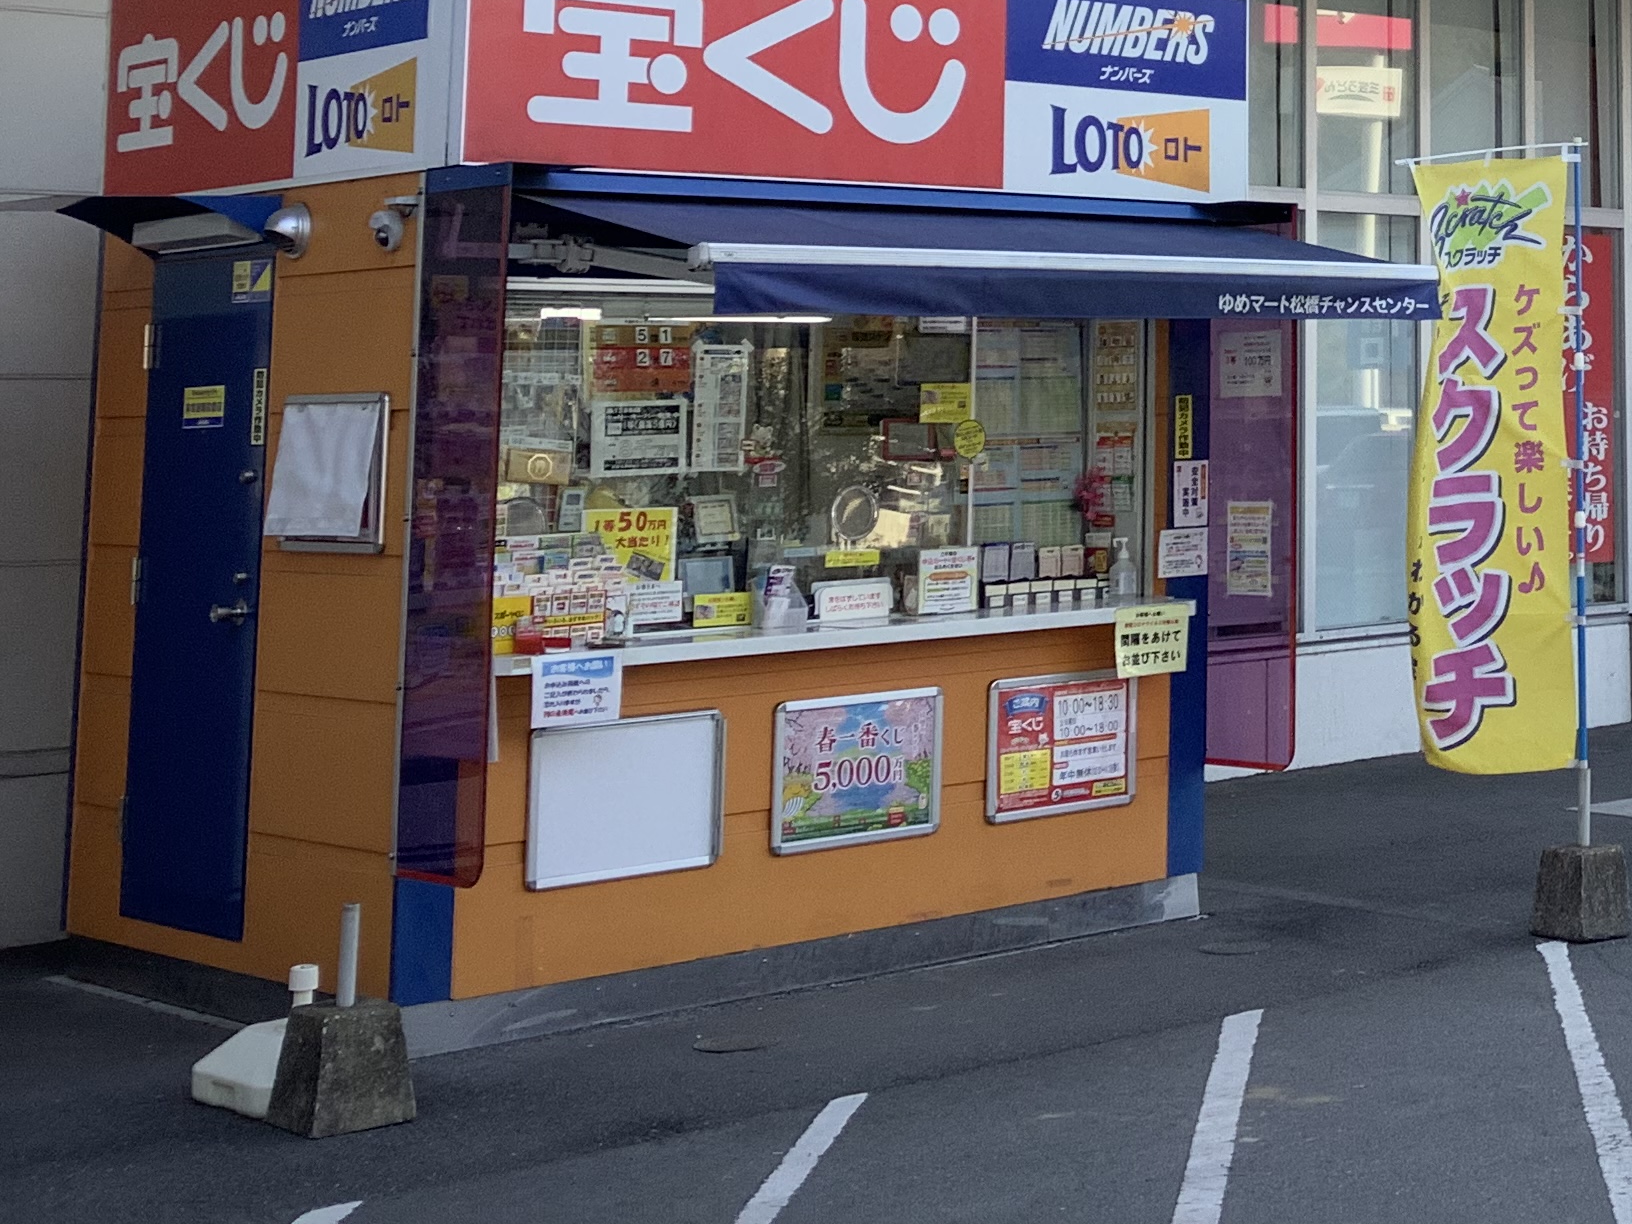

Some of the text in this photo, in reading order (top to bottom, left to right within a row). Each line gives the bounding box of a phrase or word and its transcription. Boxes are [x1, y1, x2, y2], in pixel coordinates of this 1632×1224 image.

[342, 16, 380, 38] ナンバーズ
[116, 11, 287, 153] 宝くじ
[1100, 65, 1154, 84] ナンバーズ
[305, 84, 371, 158] LOTO
[382, 95, 410, 125] ロト
[1050, 104, 1144, 175] LOTO
[1164, 136, 1201, 162] ロト
[1444, 247, 1502, 269] スクラッチ
[1218, 289, 1430, 318] ゆめマート松橋チャンスセンター
[1424, 284, 1517, 752] スクラッチ
[815, 721, 904, 754] 春一番くじ
[1007, 716, 1045, 735] 宝くじ
